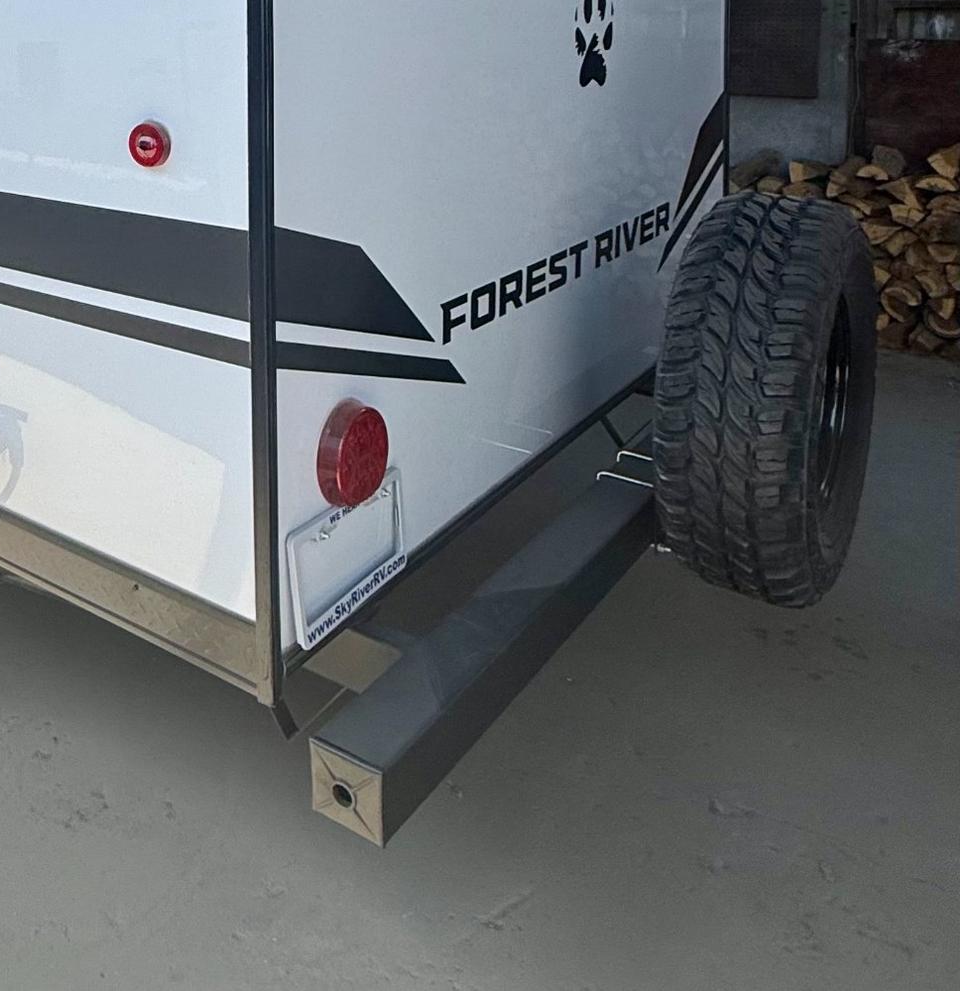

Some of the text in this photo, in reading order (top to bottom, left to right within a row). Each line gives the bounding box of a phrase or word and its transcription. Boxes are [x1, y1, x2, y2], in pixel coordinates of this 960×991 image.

[440, 201, 670, 346] FOREST RIVER
[306, 554, 406, 643] www.SkyRiverRV.com
